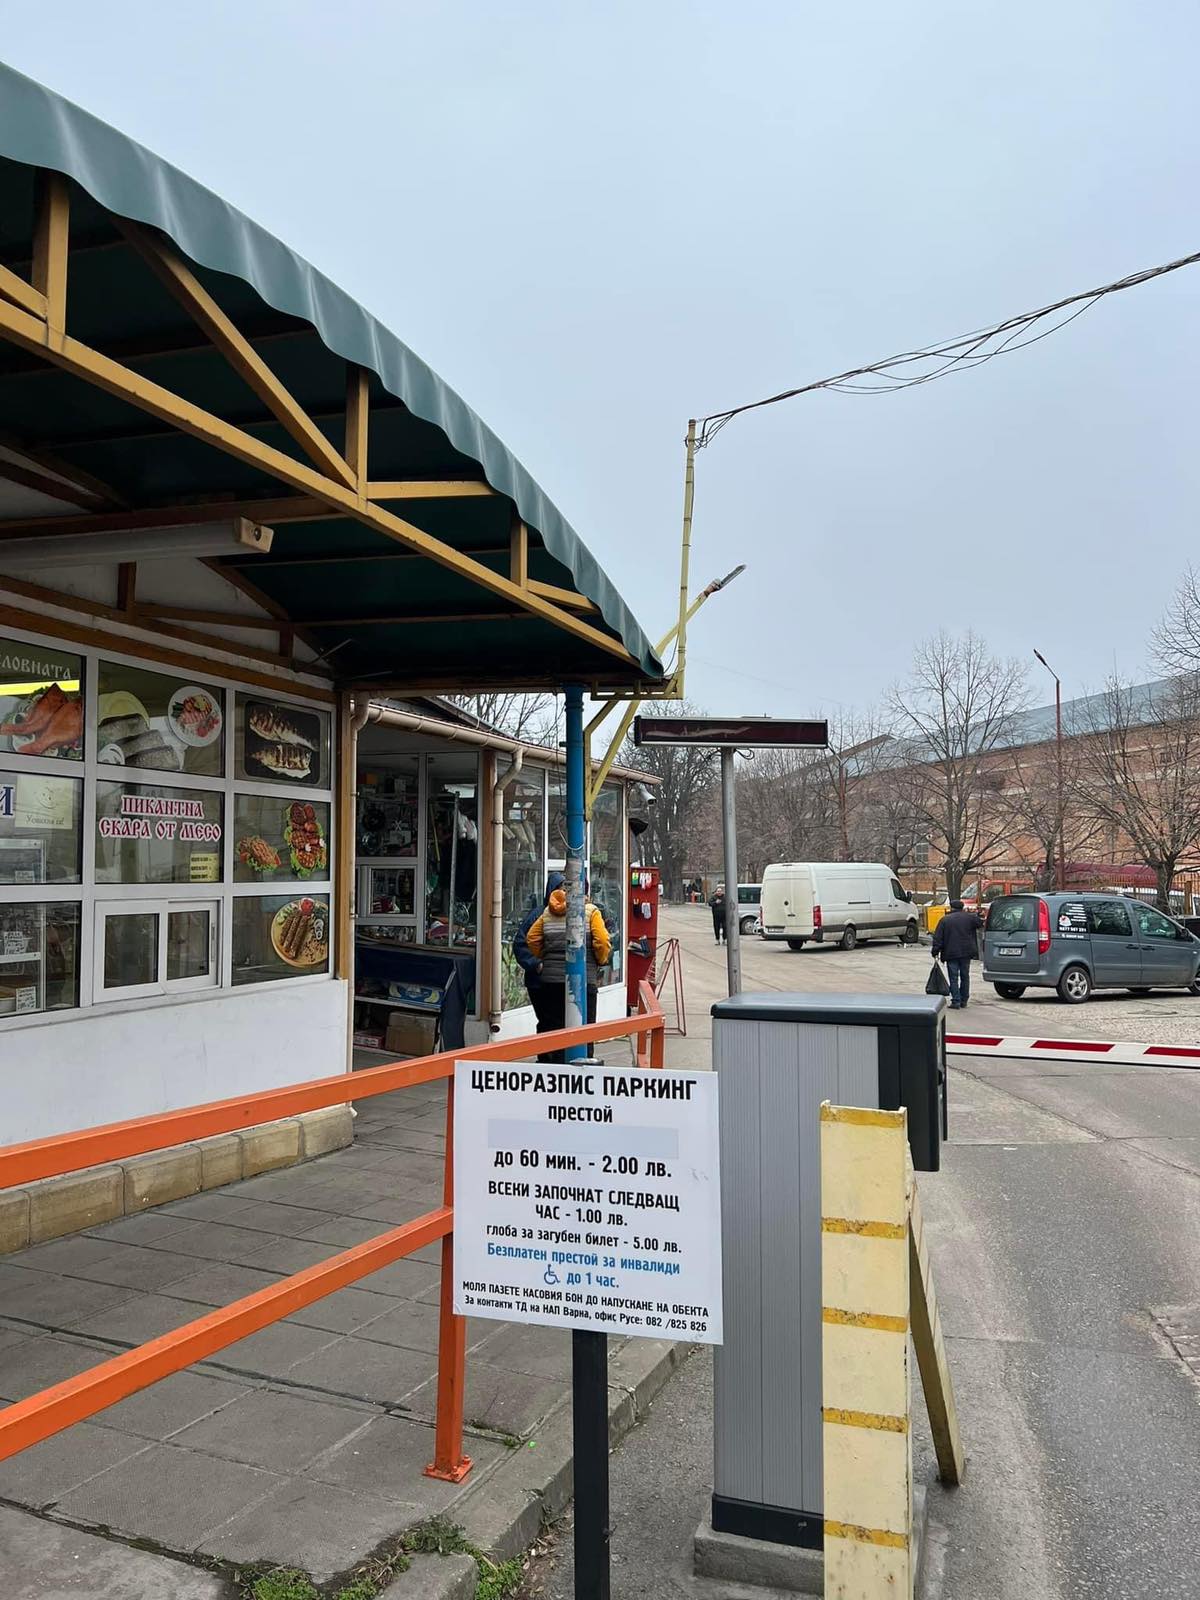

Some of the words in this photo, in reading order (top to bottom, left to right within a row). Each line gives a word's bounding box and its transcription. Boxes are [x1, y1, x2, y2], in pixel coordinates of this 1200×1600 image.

[0, 655, 71, 680] ЛОВНАТА
[122, 796, 204, 818] ПИКАНТНА
[100, 818, 151, 838] СКАРА
[156, 820, 176, 840] ОТ
[180, 822, 221, 841] МЕСО
[471, 1069, 595, 1095] ЦЕНОРАЗПИС
[603, 1076, 697, 1100] ПАРКИНГ
[548, 1105, 613, 1123] престой
[494, 1151, 514, 1168] до
[520, 1149, 539, 1168] 60
[546, 1154, 582, 1171] мин.
[602, 1155, 639, 1175] 2.00
[645, 1162, 672, 1178] лв.
[488, 1180, 530, 1198] ВСЕКИ
[535, 1184, 603, 1204] ЗАПОЧНАТ
[608, 1190, 680, 1212] СЛЕДВАЩ
[536, 1204, 560, 1220] ЧАС
[576, 1208, 602, 1224] 1.00
[607, 1213, 628, 1226] лв.
[486, 1224, 518, 1238] глоба
[521, 1227, 534, 1239] за
[538, 1229, 581, 1244] загубен
[585, 1232, 619, 1247] билет
[633, 1236, 659, 1251] 5.00
[663, 1242, 682, 1253] лв.
[487, 1242, 547, 1260] Безплатен
[551, 1251, 599, 1267] престой
[602, 1256, 616, 1268] за
[620, 1258, 681, 1275] инвалиди
[566, 1272, 582, 1285] до
[586, 1272, 592, 1285] 1
[596, 1275, 620, 1288] час.
[462, 1281, 487, 1292] МОЛЯ
[489, 1284, 520, 1297] ПАЗЕТЕ
[523, 1288, 563, 1301] КАСОВИЯ
[565, 1292, 583, 1303] БОН
[586, 1295, 598, 1306] ДО
[601, 1296, 654, 1311] НАПУСКАНЕ
[657, 1303, 669, 1313] НА
[672, 1304, 709, 1317] ОБЕКТА
[465, 1295, 475, 1305] За
[477, 1298, 513, 1310] контакти
[515, 1301, 528, 1312] ТД
[530, 1304, 540, 1313] на
[543, 1304, 560, 1315] НАП
[563, 1307, 592, 1319] Варна,
[595, 1311, 617, 1322] офис
[620, 1313, 643, 1325] Русе:
[646, 1316, 662, 1327] 082
[665, 1319, 687, 1330] /825
[690, 1322, 707, 1332] 826
